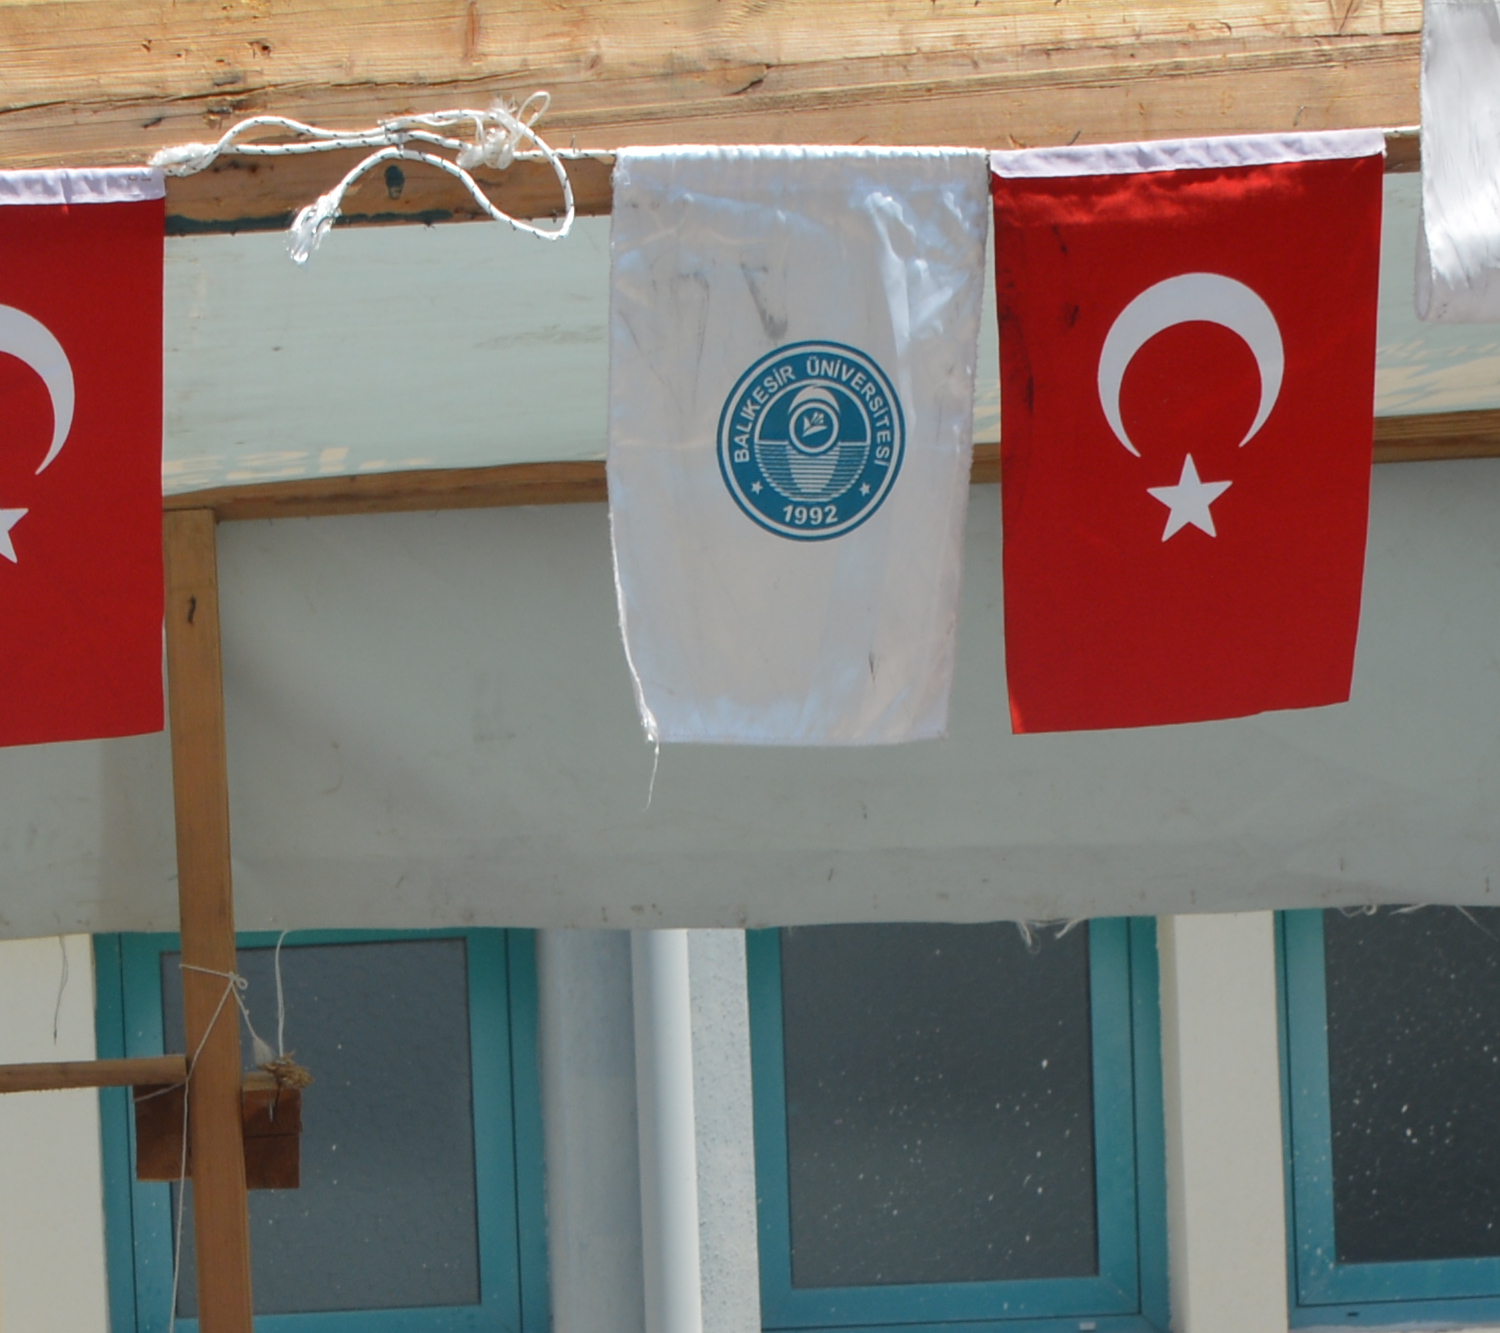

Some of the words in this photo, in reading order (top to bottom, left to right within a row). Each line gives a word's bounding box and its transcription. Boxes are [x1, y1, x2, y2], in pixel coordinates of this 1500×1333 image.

[734, 365, 796, 463] BALIKESİR
[806, 356, 891, 467] ÜNİVERSİTESİ
[783, 505, 838, 525] 1992
